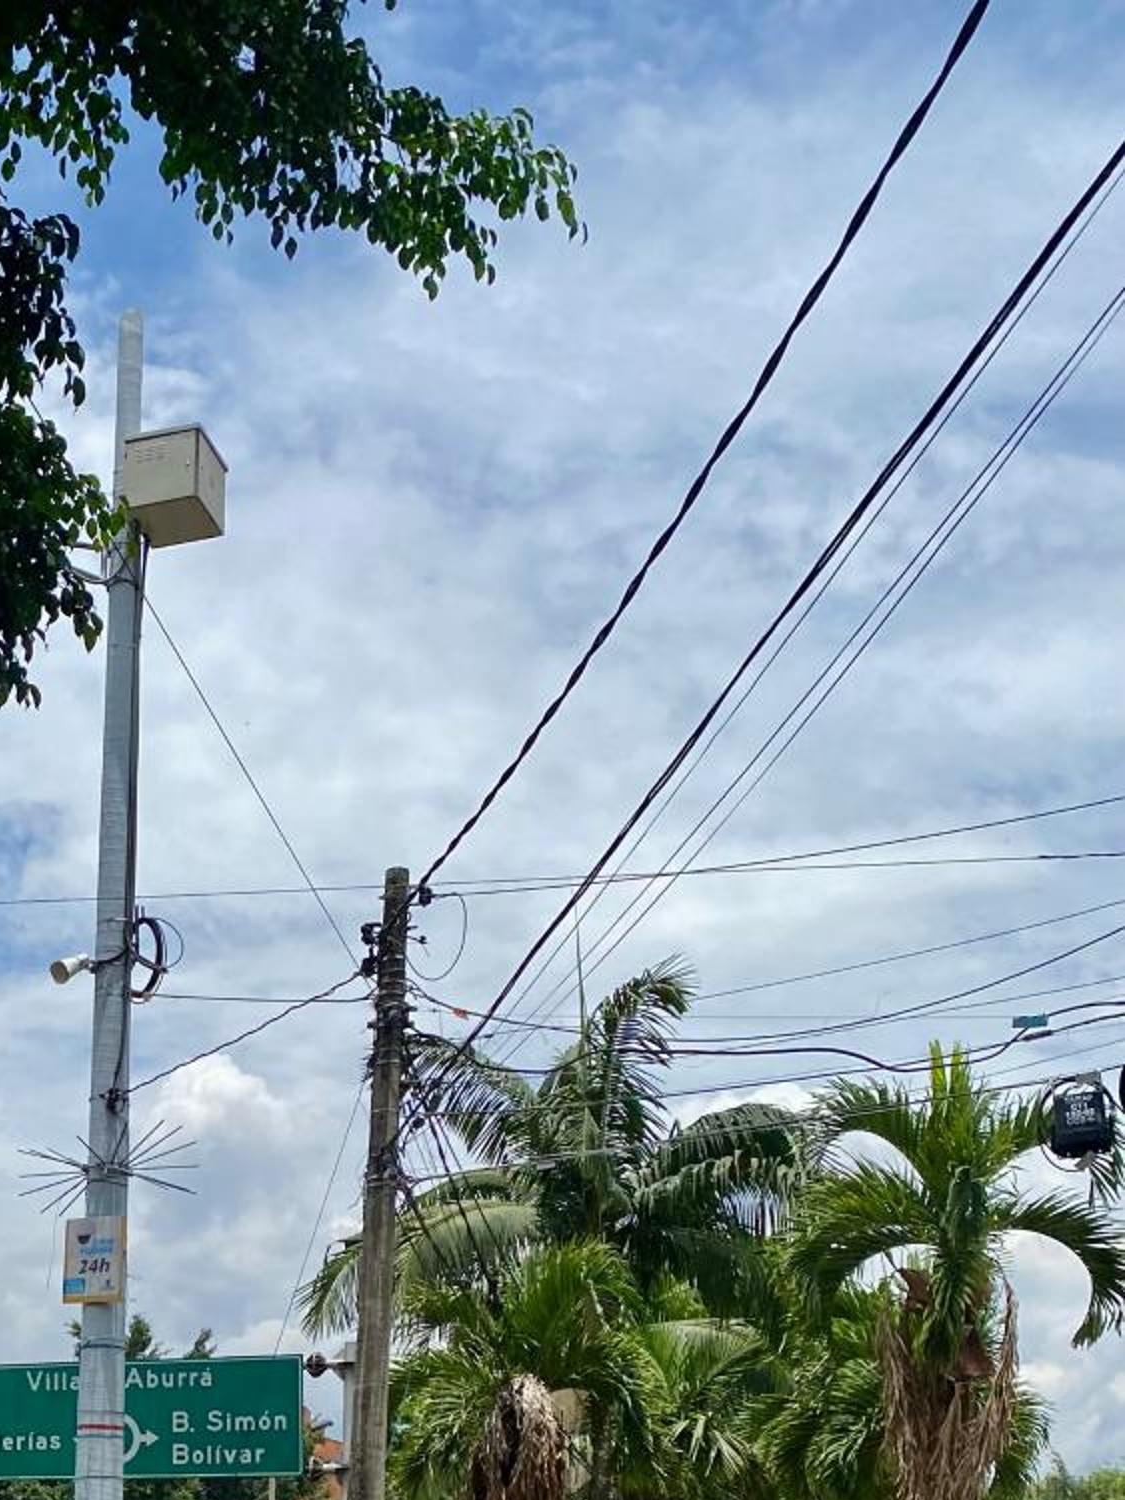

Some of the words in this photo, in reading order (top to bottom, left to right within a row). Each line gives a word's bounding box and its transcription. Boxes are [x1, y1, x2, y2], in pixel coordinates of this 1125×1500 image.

[78, 1258, 111, 1275] 24h
[26, 1370, 80, 1392] Villa
[125, 1366, 213, 1389] Aburrá
[172, 1410, 196, 1433] B.
[206, 1409, 288, 1433] Simón
[172, 1443, 267, 1466] Bolívar
